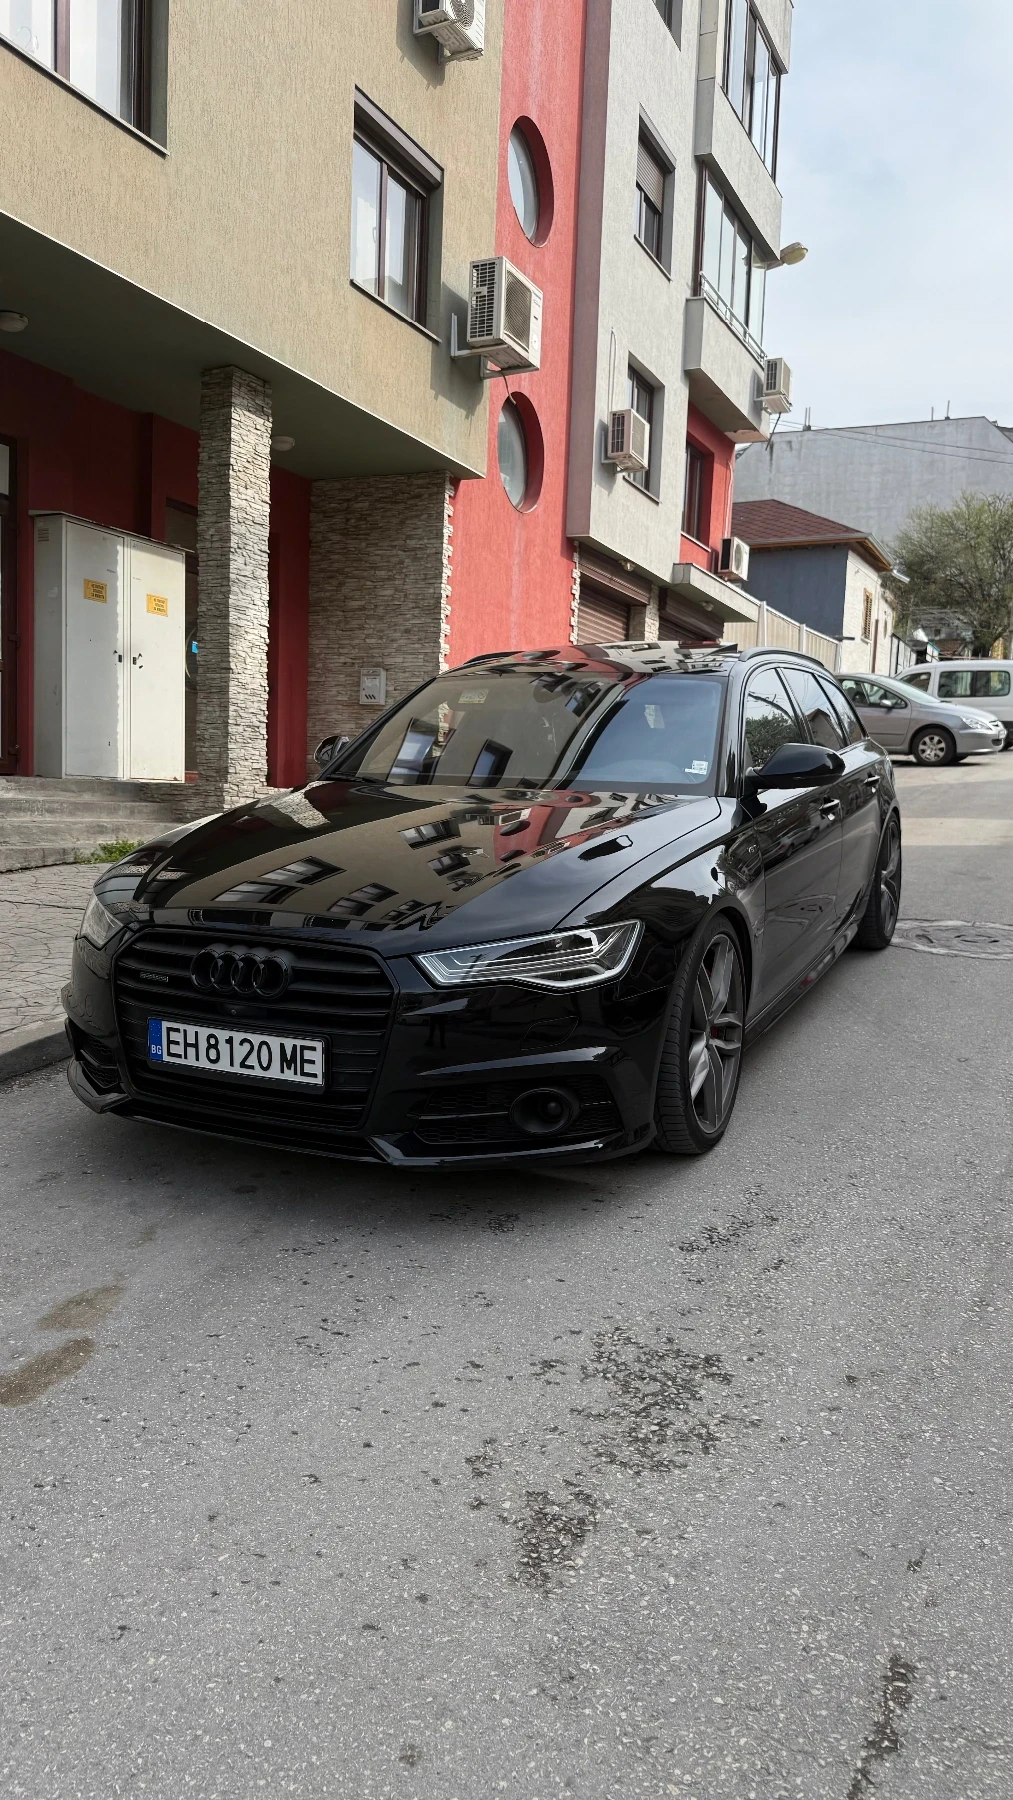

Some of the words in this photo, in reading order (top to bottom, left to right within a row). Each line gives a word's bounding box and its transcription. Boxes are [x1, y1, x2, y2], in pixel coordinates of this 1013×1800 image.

[151, 1044, 162, 1055] BG
[166, 1026, 200, 1062] EH
[205, 1033, 273, 1072] 8120
[279, 1042, 318, 1079] ME
